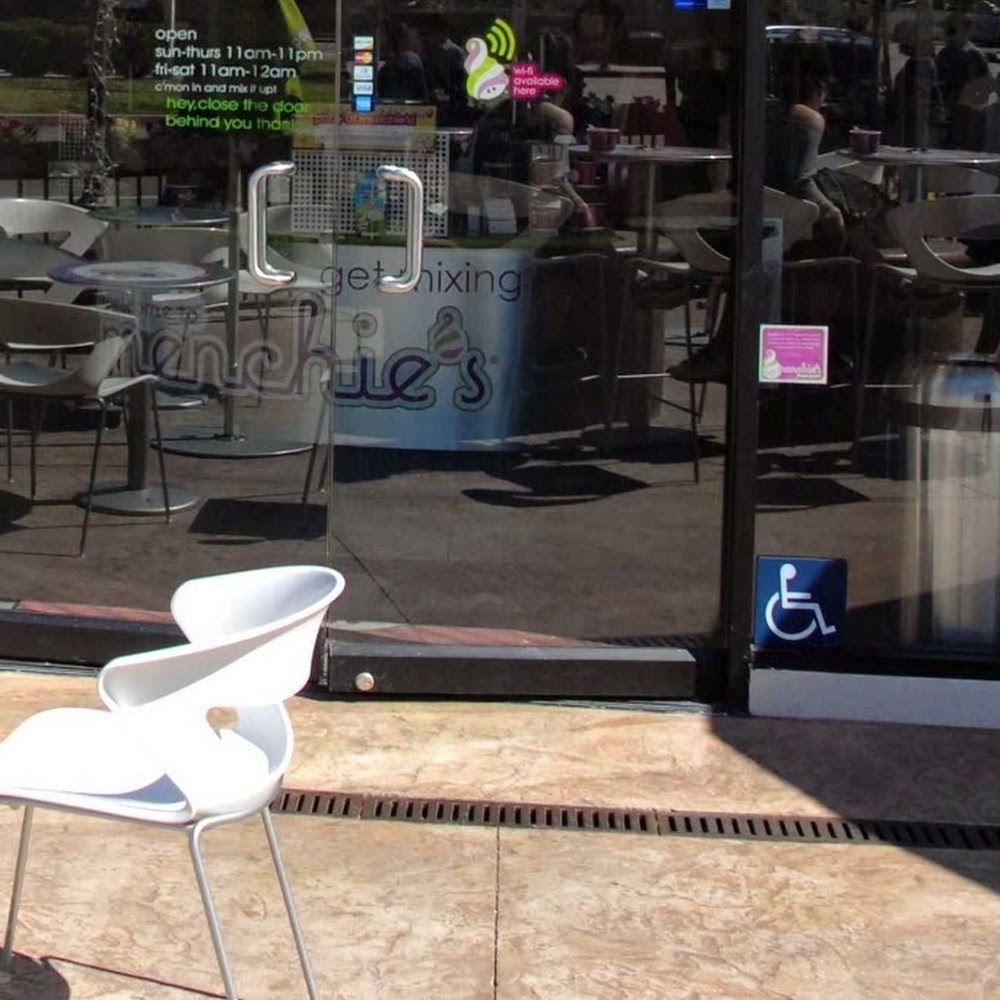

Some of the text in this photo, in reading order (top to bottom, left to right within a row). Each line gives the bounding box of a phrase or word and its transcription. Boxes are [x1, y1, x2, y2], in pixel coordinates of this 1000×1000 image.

[155, 28, 197, 43] open
[192, 82, 202, 92] in
[204, 82, 227, 93] and
[229, 83, 248, 93] mix
[513, 76, 560, 86] available
[513, 86, 536, 95] here
[243, 98, 268, 112] the
[272, 99, 310, 113] door
[165, 114, 220, 129] behind
[223, 118, 252, 131] you
[320, 261, 384, 296] get
